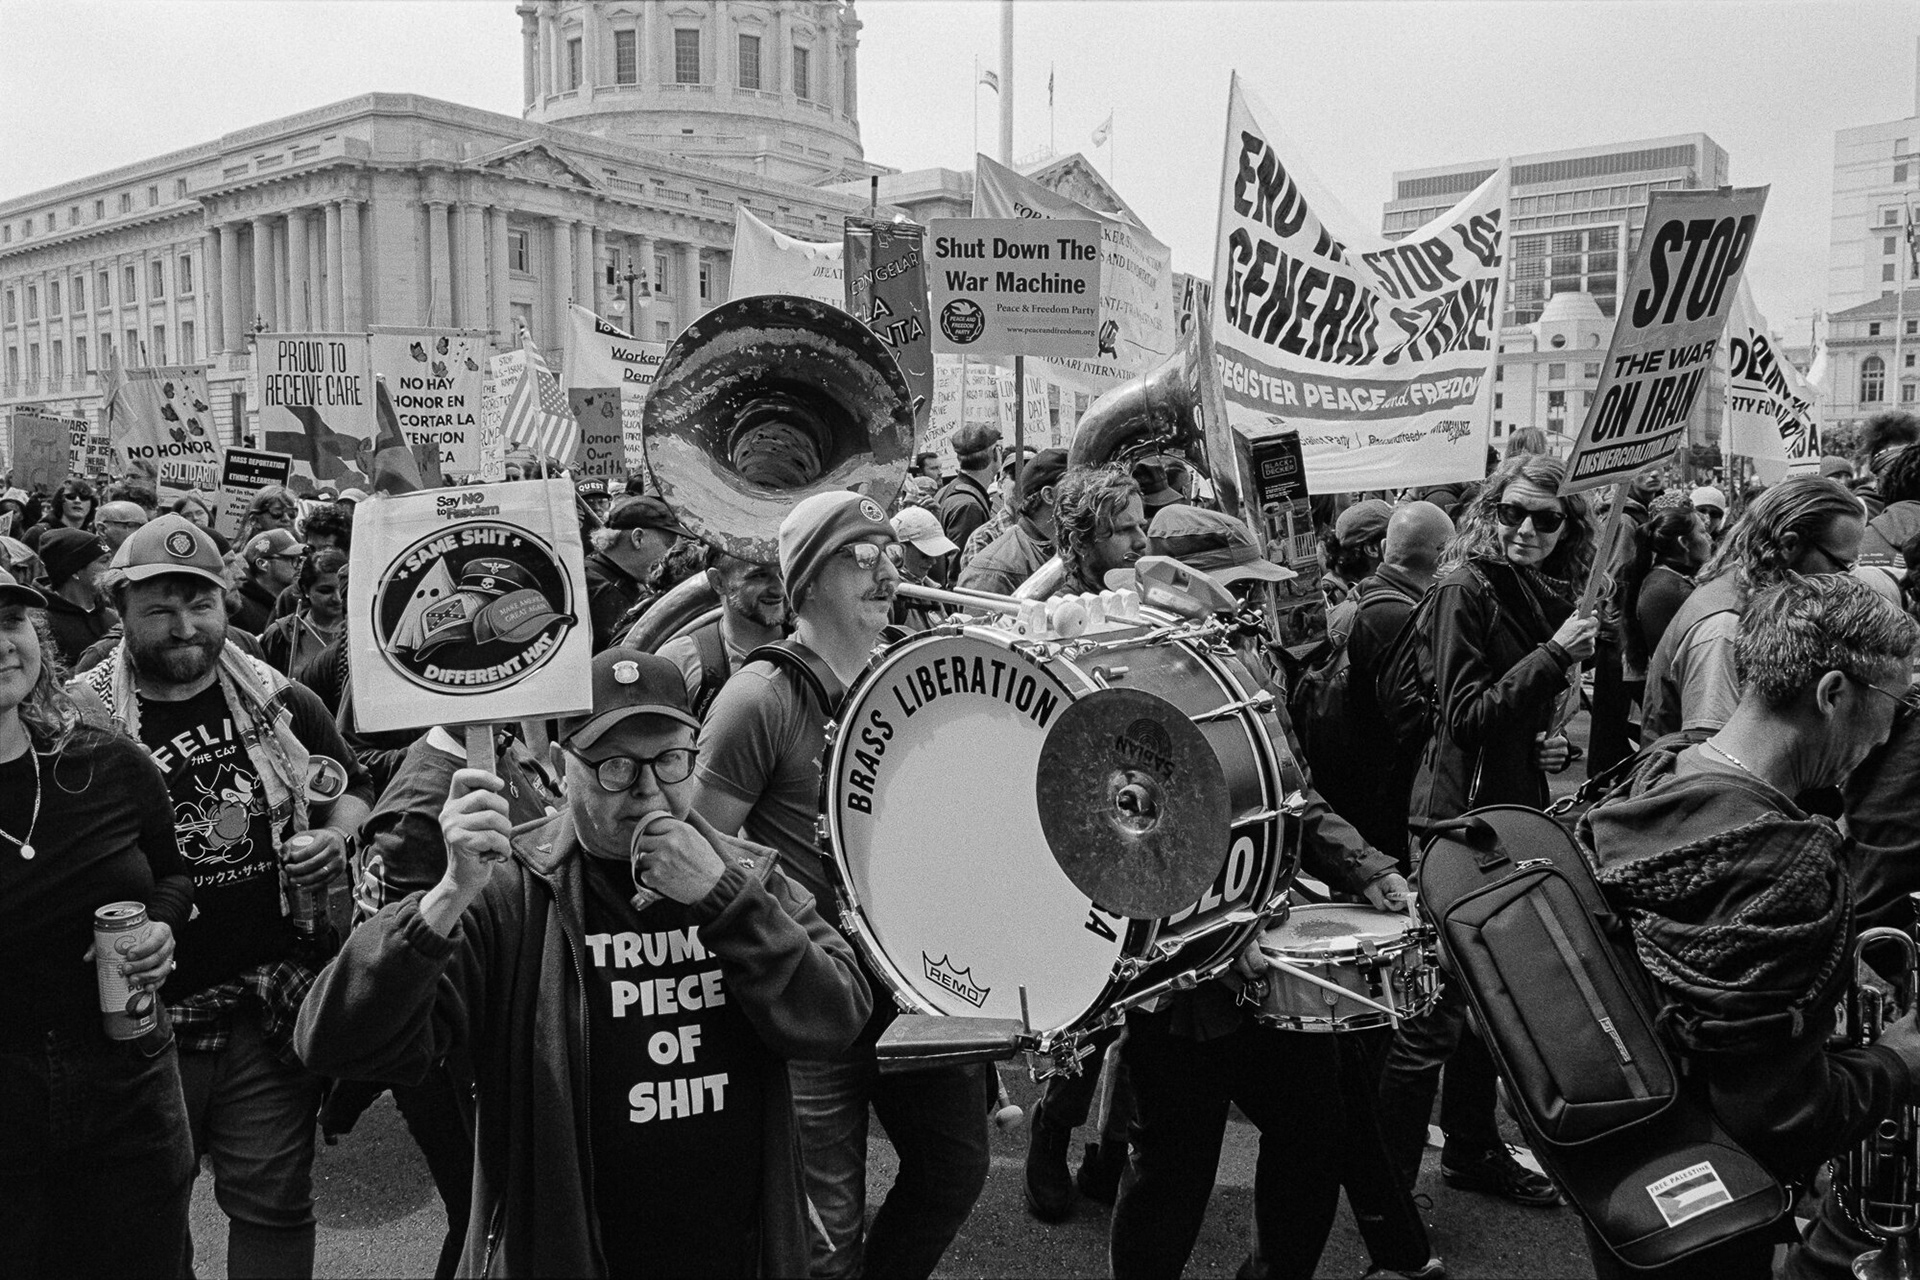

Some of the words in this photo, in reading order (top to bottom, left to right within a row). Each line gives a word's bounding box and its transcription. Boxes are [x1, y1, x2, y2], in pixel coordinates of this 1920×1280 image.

[935, 236, 986, 259] Shut
[993, 237, 1050, 260] Down
[1056, 238, 1096, 261] The
[851, 251, 920, 297] CONGELAR
[945, 270, 989, 292] War
[996, 271, 1086, 294] Machine
[1362, 236, 1461, 300] STOP
[1632, 214, 1756, 329] STOP
[862, 297, 893, 324] LA
[996, 304, 1020, 313] Peace
[1022, 304, 1030, 313] &
[1031, 304, 1070, 314] Freedom
[1072, 306, 1096, 316] Party
[1225, 226, 1380, 366] GENERAL
[874, 316, 926, 348] NTA
[1006, 326, 1096, 337] www.peaceandfreedom.org
[278, 340, 325, 373] PROUD
[328, 342, 347, 373] TO
[1615, 348, 1665, 378] THE
[1668, 339, 1716, 371] WAR
[265, 374, 323, 406] RECEIVE
[326, 375, 363, 406] CARE
[400, 377, 424, 390] NO
[427, 377, 455, 390] HAY
[624, 367, 654, 384] Dem
[1216, 353, 1300, 406] REGISTER
[1303, 382, 1387, 412] PEACE
[447, 395, 465, 408] EN
[1591, 381, 1642, 444] ON
[1635, 367, 1704, 434] IRAN
[1732, 396, 1757, 413] RTY
[399, 414, 453, 428] CORTAR
[457, 413, 476, 426] LA
[127, 445, 154, 459] NO
[157, 441, 215, 458] HONOR
[405, 431, 465, 445] TENCION
[230, 455, 248, 464] MASS
[248, 458, 286, 470] DEPORTATION
[587, 447, 612, 461] Our
[229, 473, 248, 482] ETHNIC
[579, 483, 604, 493] QUEST
[436, 496, 461, 509] Say
[462, 492, 485, 506] NO
[437, 508, 447, 516] to
[446, 505, 500, 519] Fascism
[406, 534, 459, 572] SAME
[461, 529, 511, 547] SHIT
[423, 656, 523, 685] DIFFERENT
[521, 632, 554, 665] HAT
[150, 718, 233, 774] FELI
[848, 709, 894, 815] BRASS
[892, 656, 1059, 729] LIBERATION
[585, 925, 717, 968] TRUM
[611, 969, 726, 1018] PIECE
[929, 966, 979, 1002] REMO
[648, 1024, 702, 1065] OF
[628, 1072, 729, 1124] SHIT
[1650, 1181, 1668, 1193] FREE
[1669, 1164, 1710, 1184] PALESTINE
